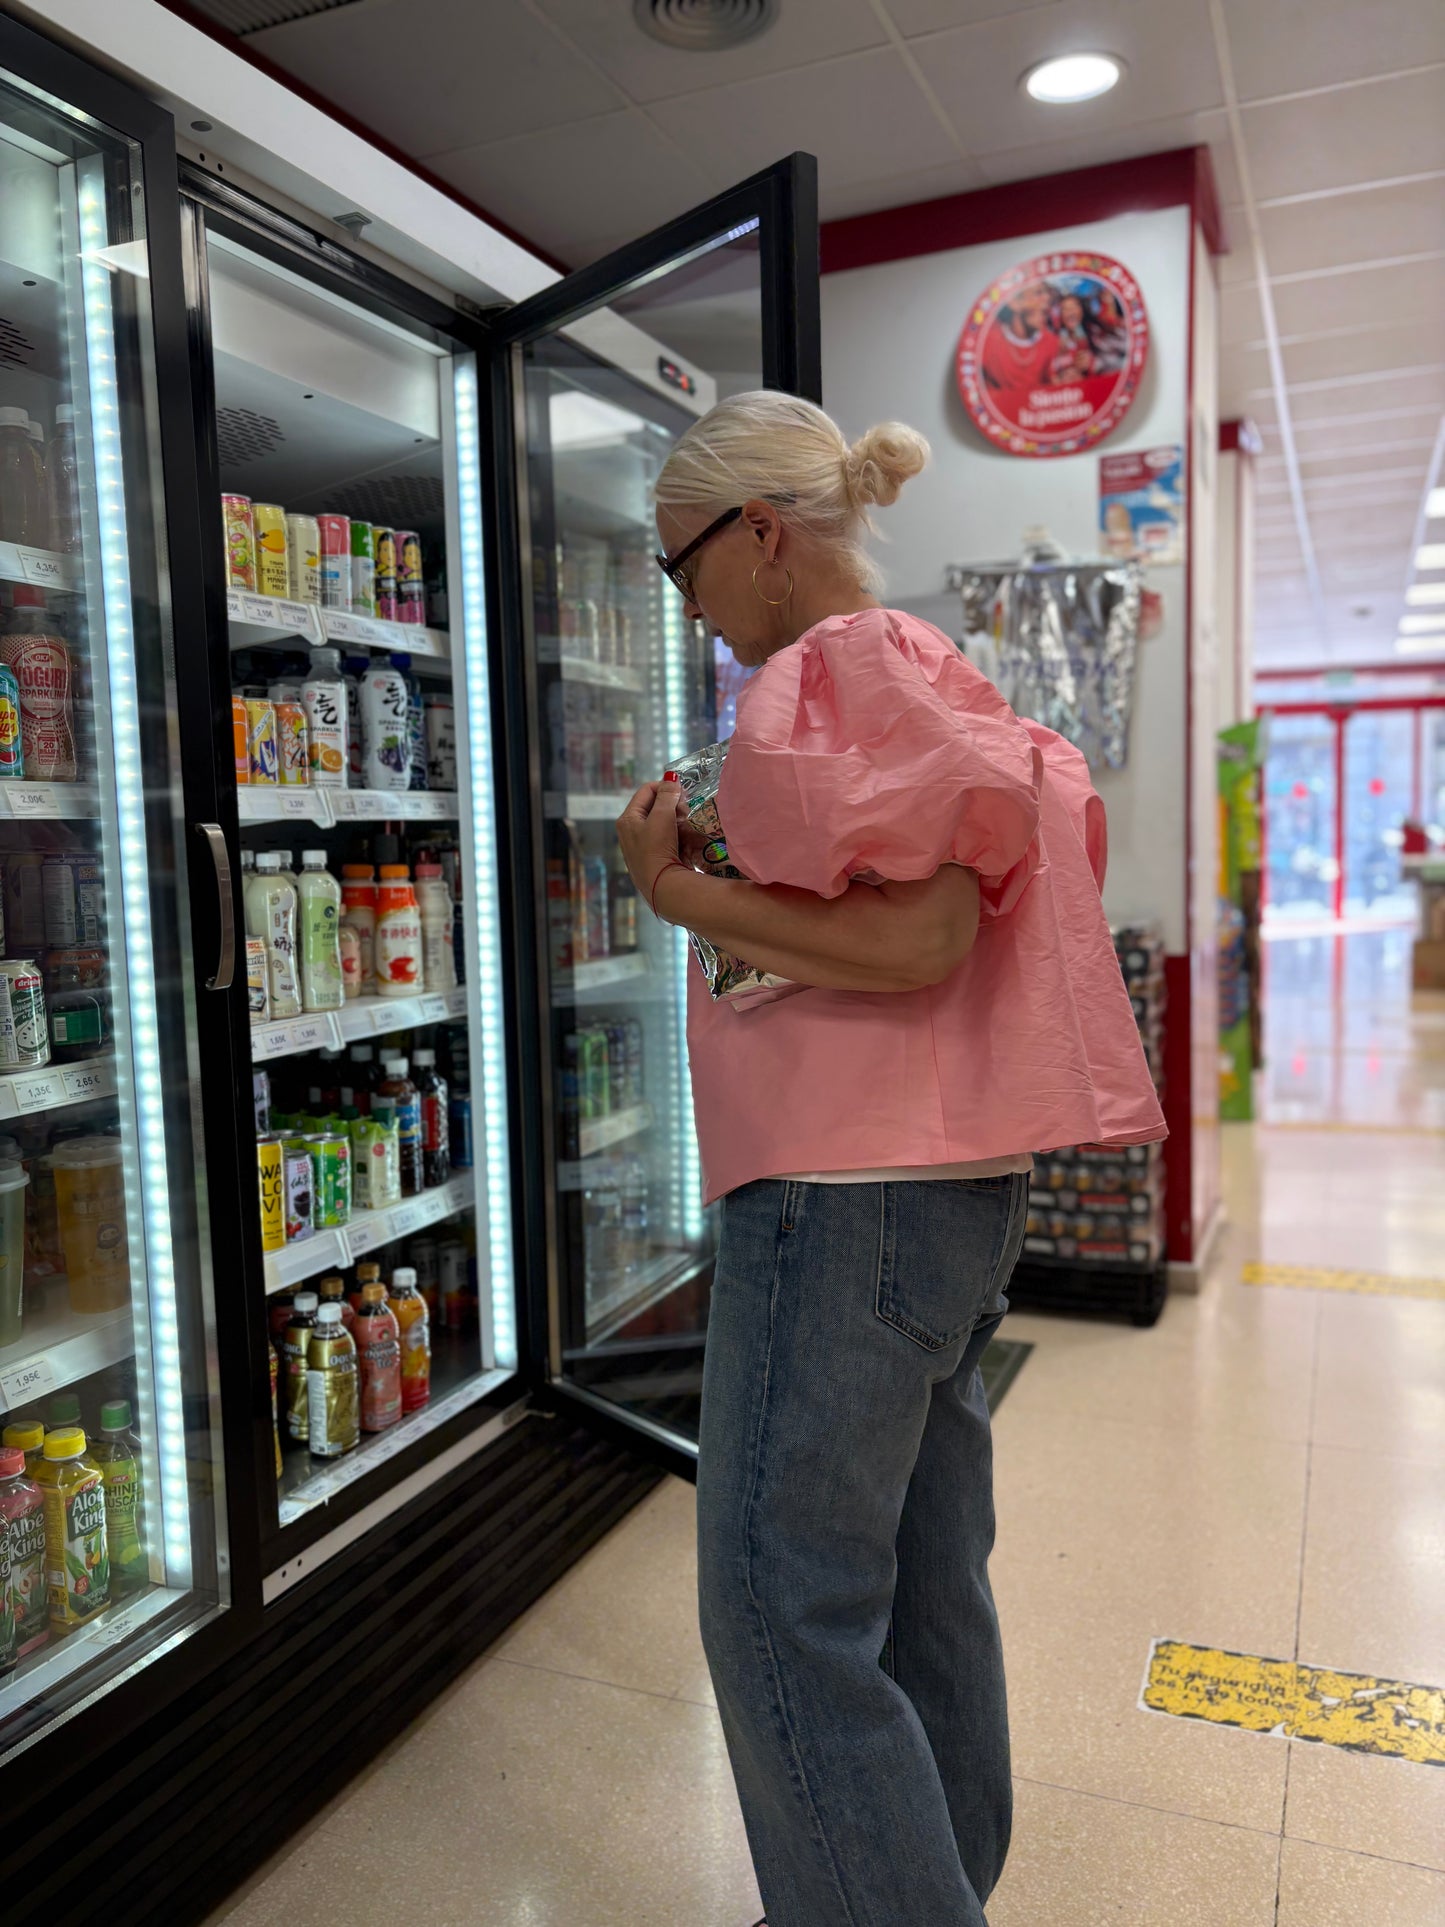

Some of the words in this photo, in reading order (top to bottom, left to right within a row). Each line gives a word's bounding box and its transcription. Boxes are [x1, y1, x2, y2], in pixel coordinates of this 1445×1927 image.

[28, 1084, 52, 1098] 1,35€
[76, 1076, 93, 1088] 2,65
[15, 1370, 41, 1387] 1,95€
[72, 1485, 105, 1517] Aloe
[10, 1512, 45, 1539] Aloe
[73, 1507, 106, 1534] King
[10, 1531, 46, 1562] King
